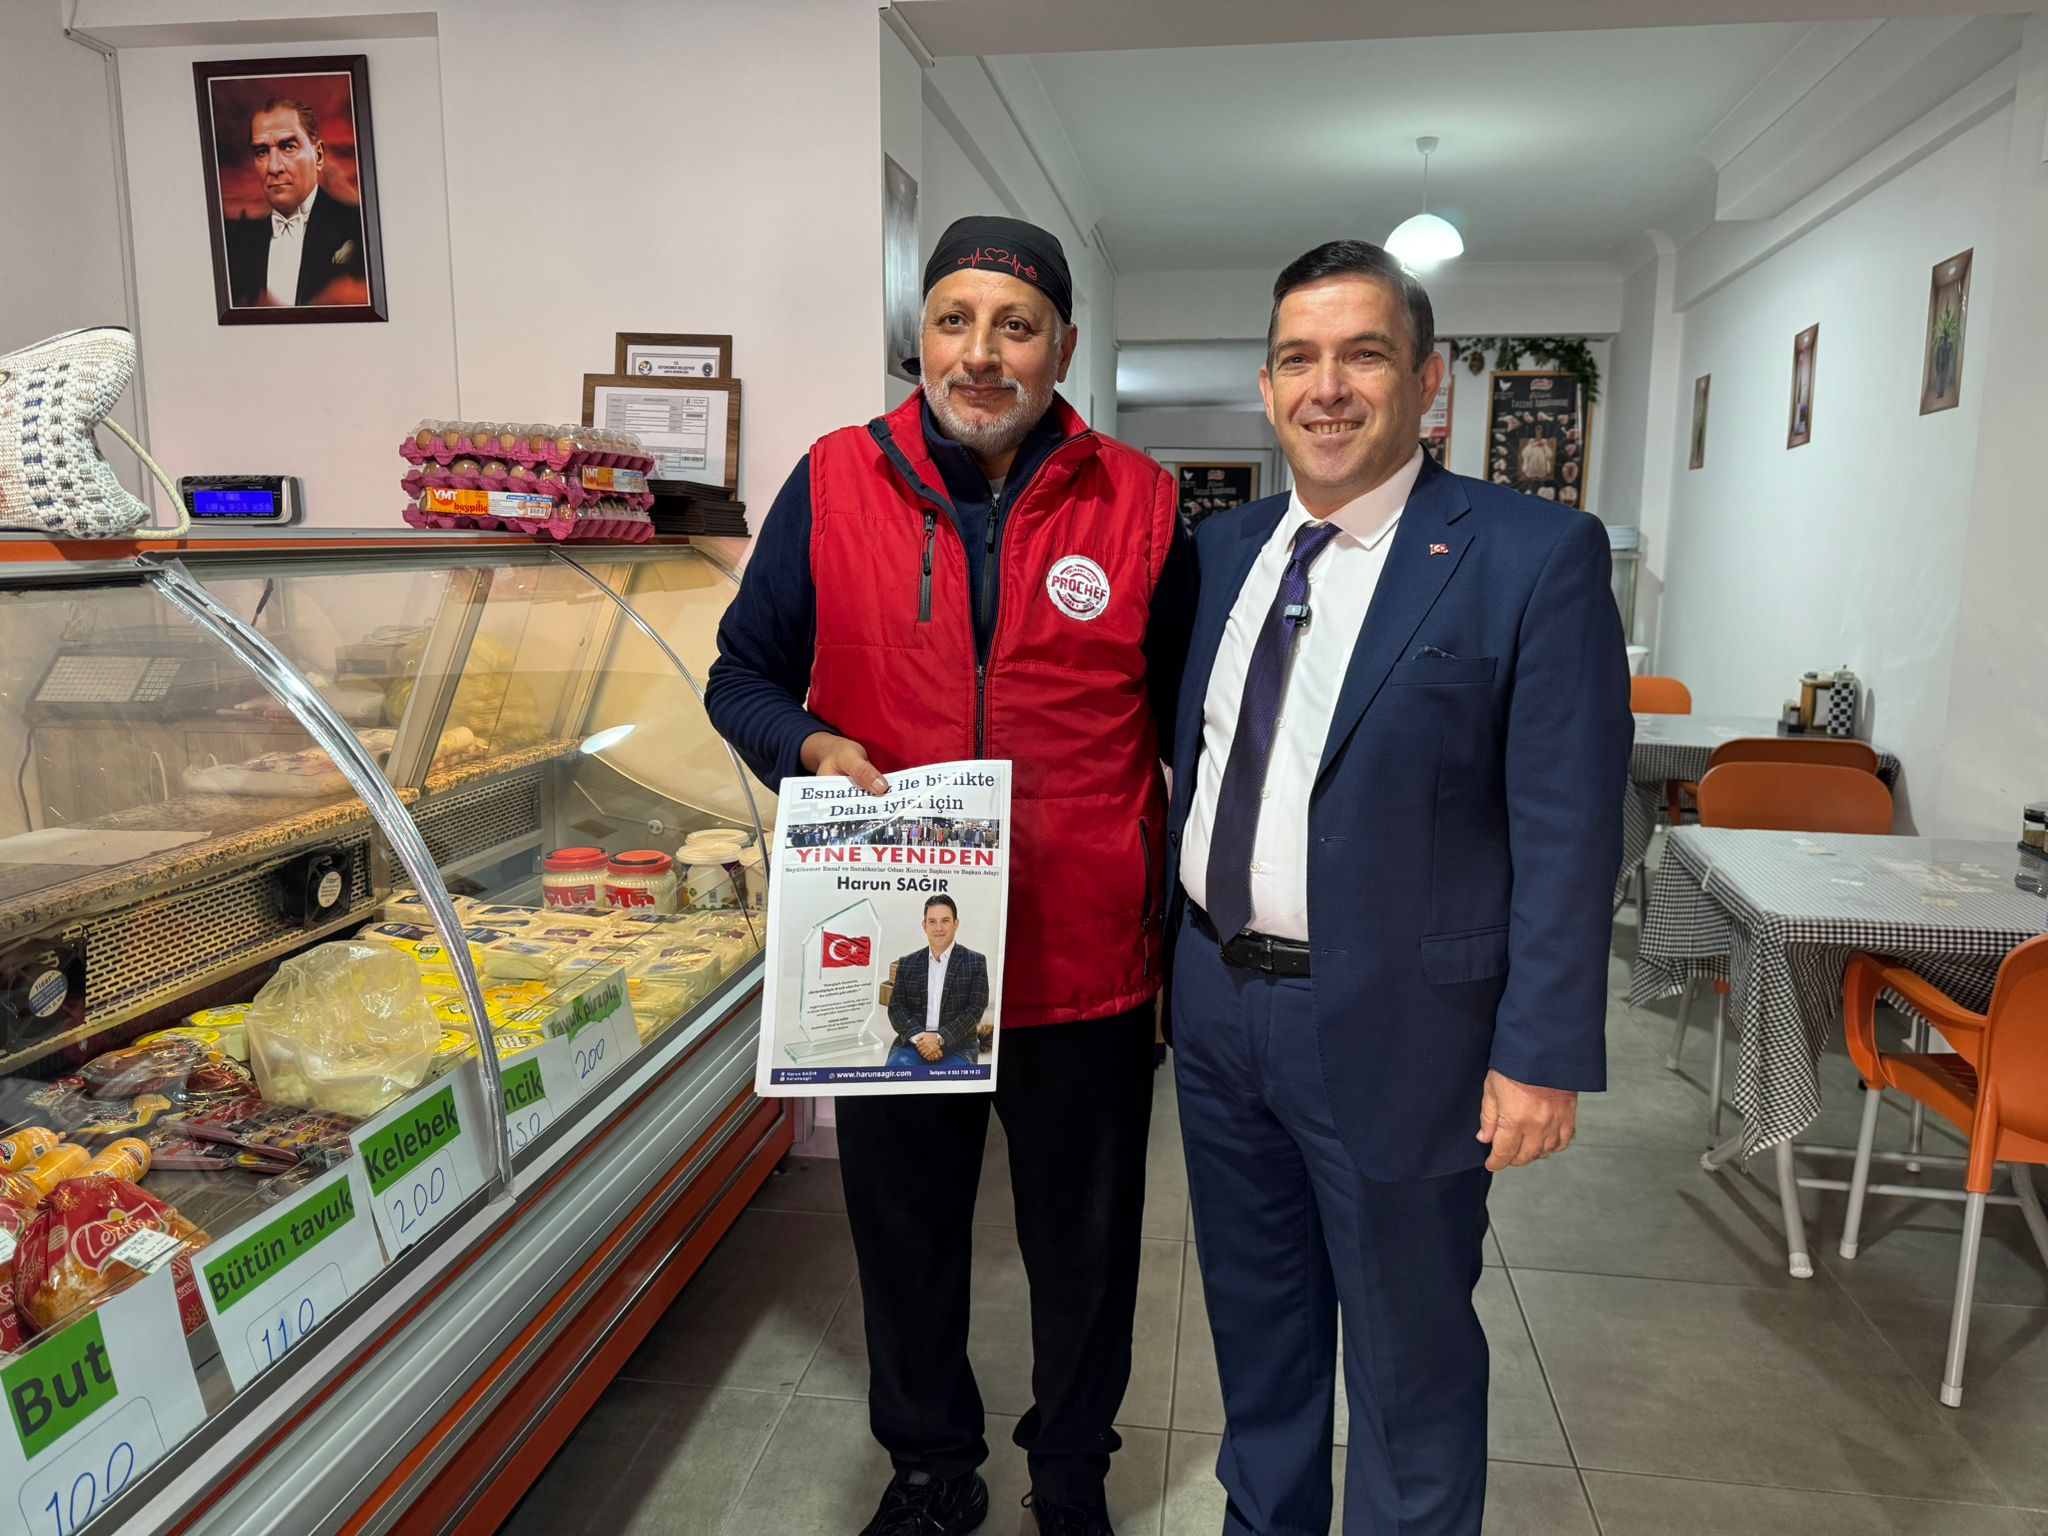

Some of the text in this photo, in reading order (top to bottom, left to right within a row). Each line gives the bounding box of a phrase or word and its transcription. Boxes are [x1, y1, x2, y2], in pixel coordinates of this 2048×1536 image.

[433, 489, 458, 501] YMT
[1051, 575, 1107, 602] PROCHEF
[829, 805, 878, 817] Daha
[928, 795, 964, 814] için
[899, 779, 920, 792] ile
[837, 874, 949, 893] Harun SAĞIR
[583, 983, 621, 1021] pirzola
[575, 1038, 605, 1080] 200
[836, 1069, 912, 1080] www.harunsagir.com
[503, 1070, 545, 1111] ncik
[363, 1099, 459, 1187] Kelebek
[507, 1112, 541, 1153] 150
[393, 1166, 445, 1234] 200
[207, 1241, 287, 1304] Bütün
[290, 1188, 354, 1259] tavuk
[261, 1297, 315, 1360] 110
[10, 1339, 112, 1438] But
[45, 1441, 135, 1536] 100
